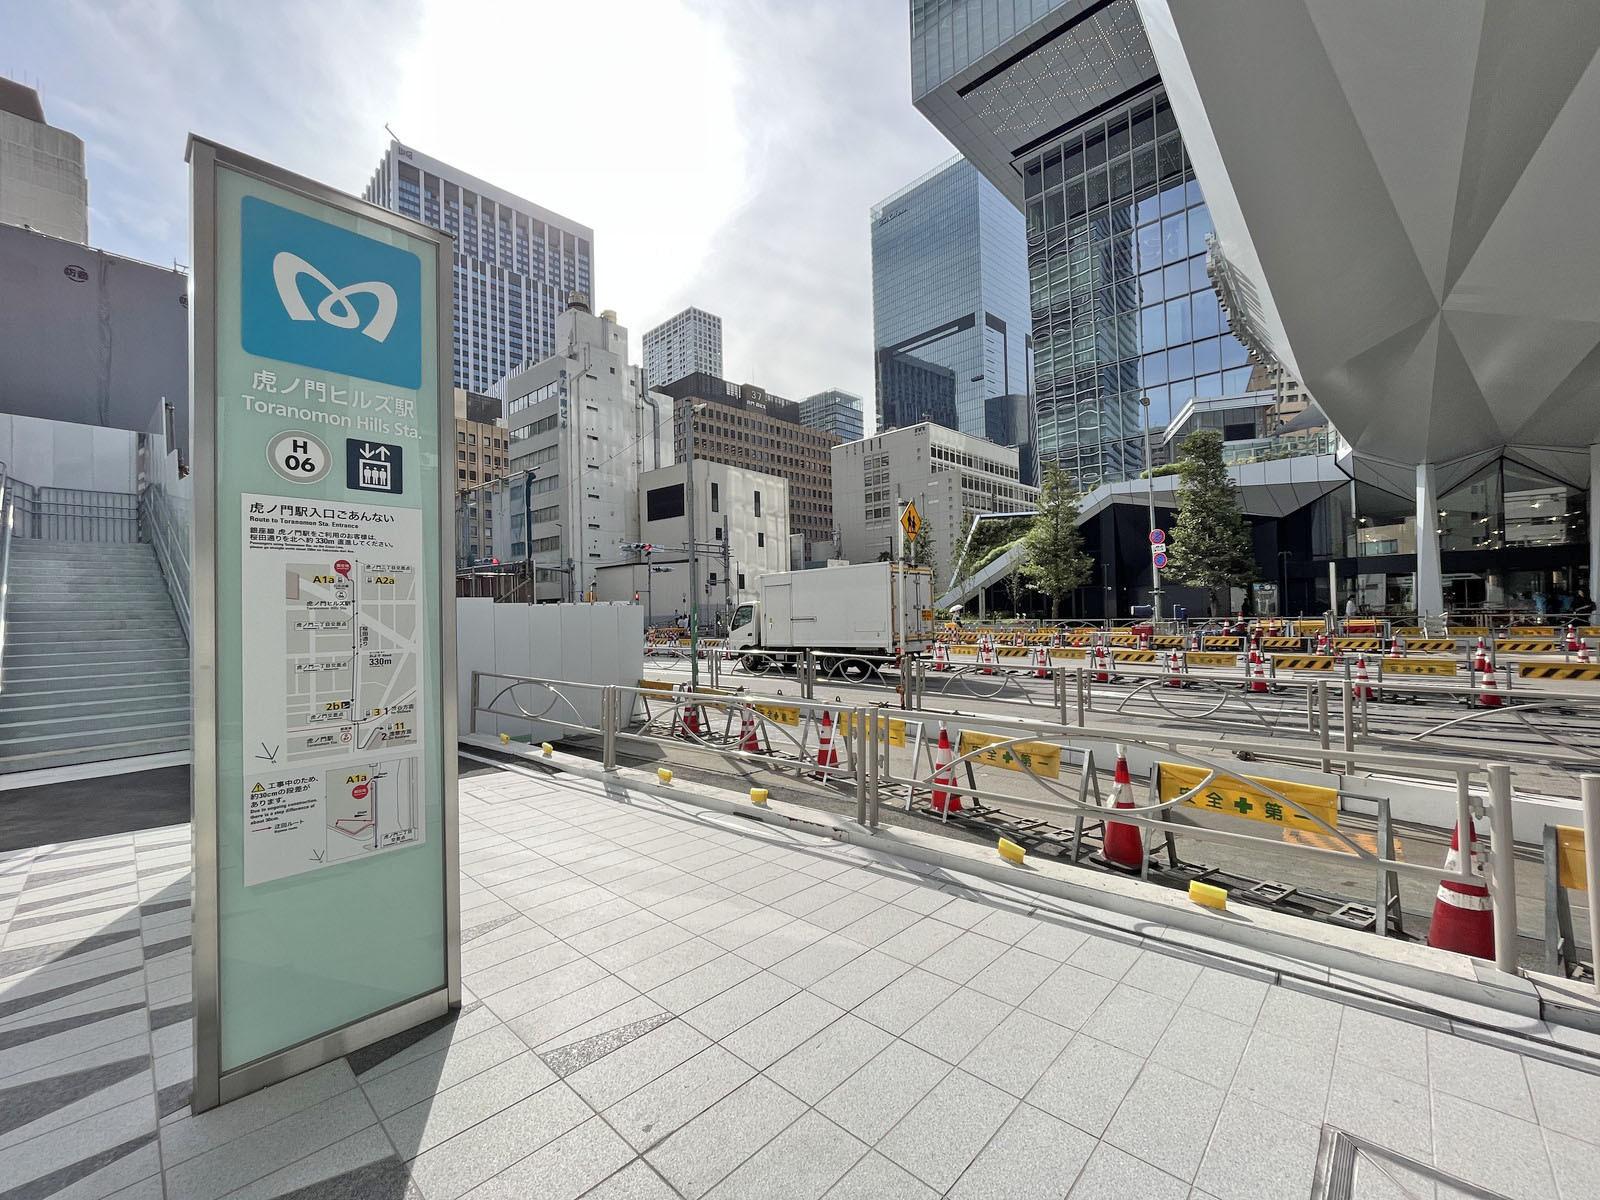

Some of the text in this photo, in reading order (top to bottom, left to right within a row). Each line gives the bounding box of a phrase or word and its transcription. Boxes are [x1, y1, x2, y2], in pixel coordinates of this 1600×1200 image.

[252, 369, 414, 419] 虎ノ門ヒルズ駅
[751, 390, 762, 401] 37
[241, 394, 422, 440] Toranomon Hills Sta.
[293, 439, 308, 455] H
[285, 455, 316, 473] 06
[249, 502, 395, 523] 虎ノ門駅入口ごあんない
[249, 515, 270, 523] Route
[280, 517, 317, 527] Toranomon
[332, 521, 359, 529] Entrance
[313, 575, 335, 584] A1a
[375, 577, 395, 585] A2a
[369, 657, 392, 666] 330m
[326, 702, 340, 711] 2b
[373, 708, 380, 716] 3
[395, 722, 404, 730] 11
[381, 732, 387, 741] 2
[346, 774, 367, 785] A1a
